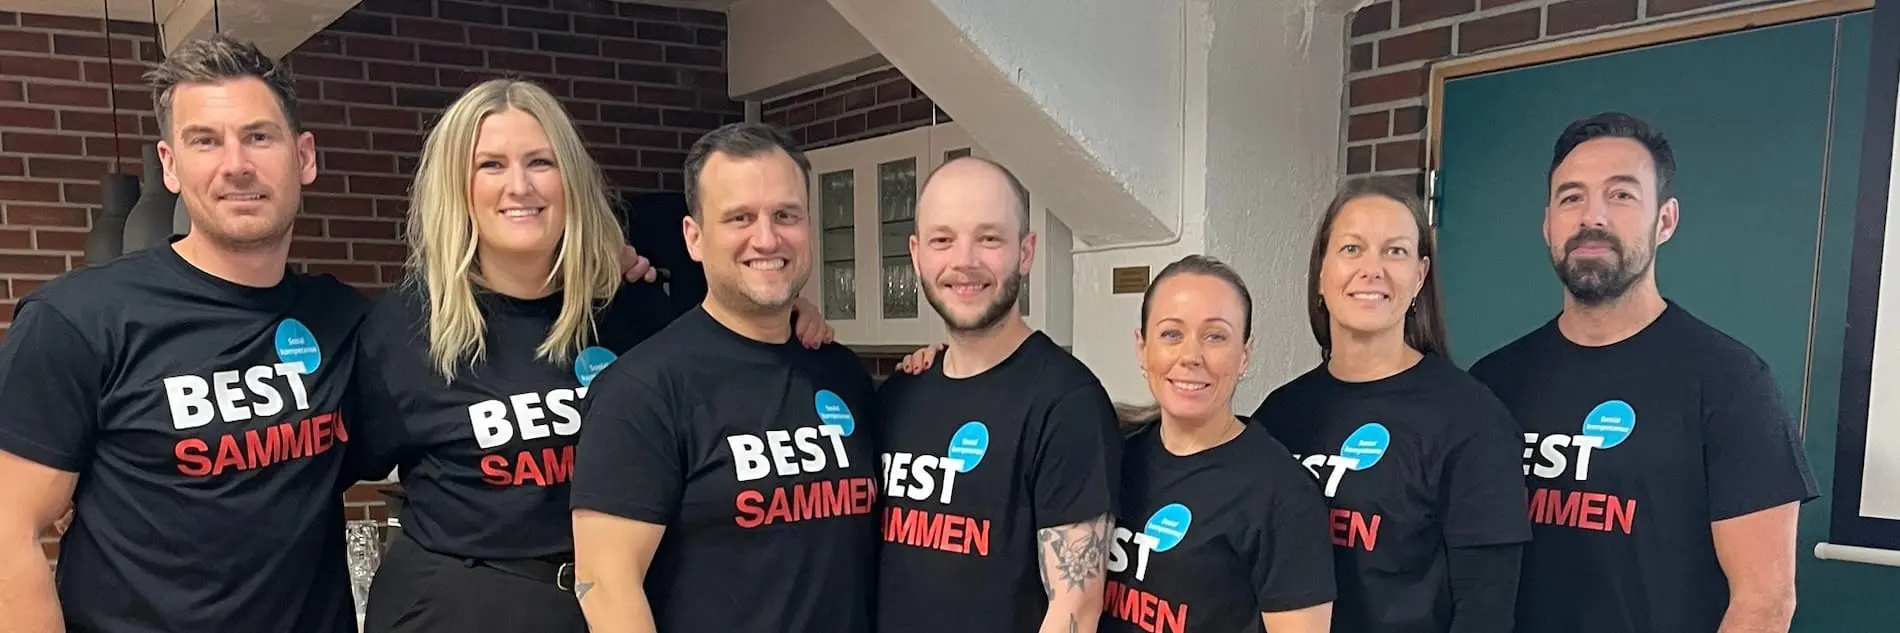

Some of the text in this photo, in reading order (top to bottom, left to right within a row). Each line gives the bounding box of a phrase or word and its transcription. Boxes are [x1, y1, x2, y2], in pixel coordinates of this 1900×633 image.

[164, 361, 309, 430] BEST
[480, 444, 577, 487] SAM
[727, 424, 850, 482] BEST
[884, 507, 991, 556] MMEN
[1527, 488, 1637, 534] MMEN
